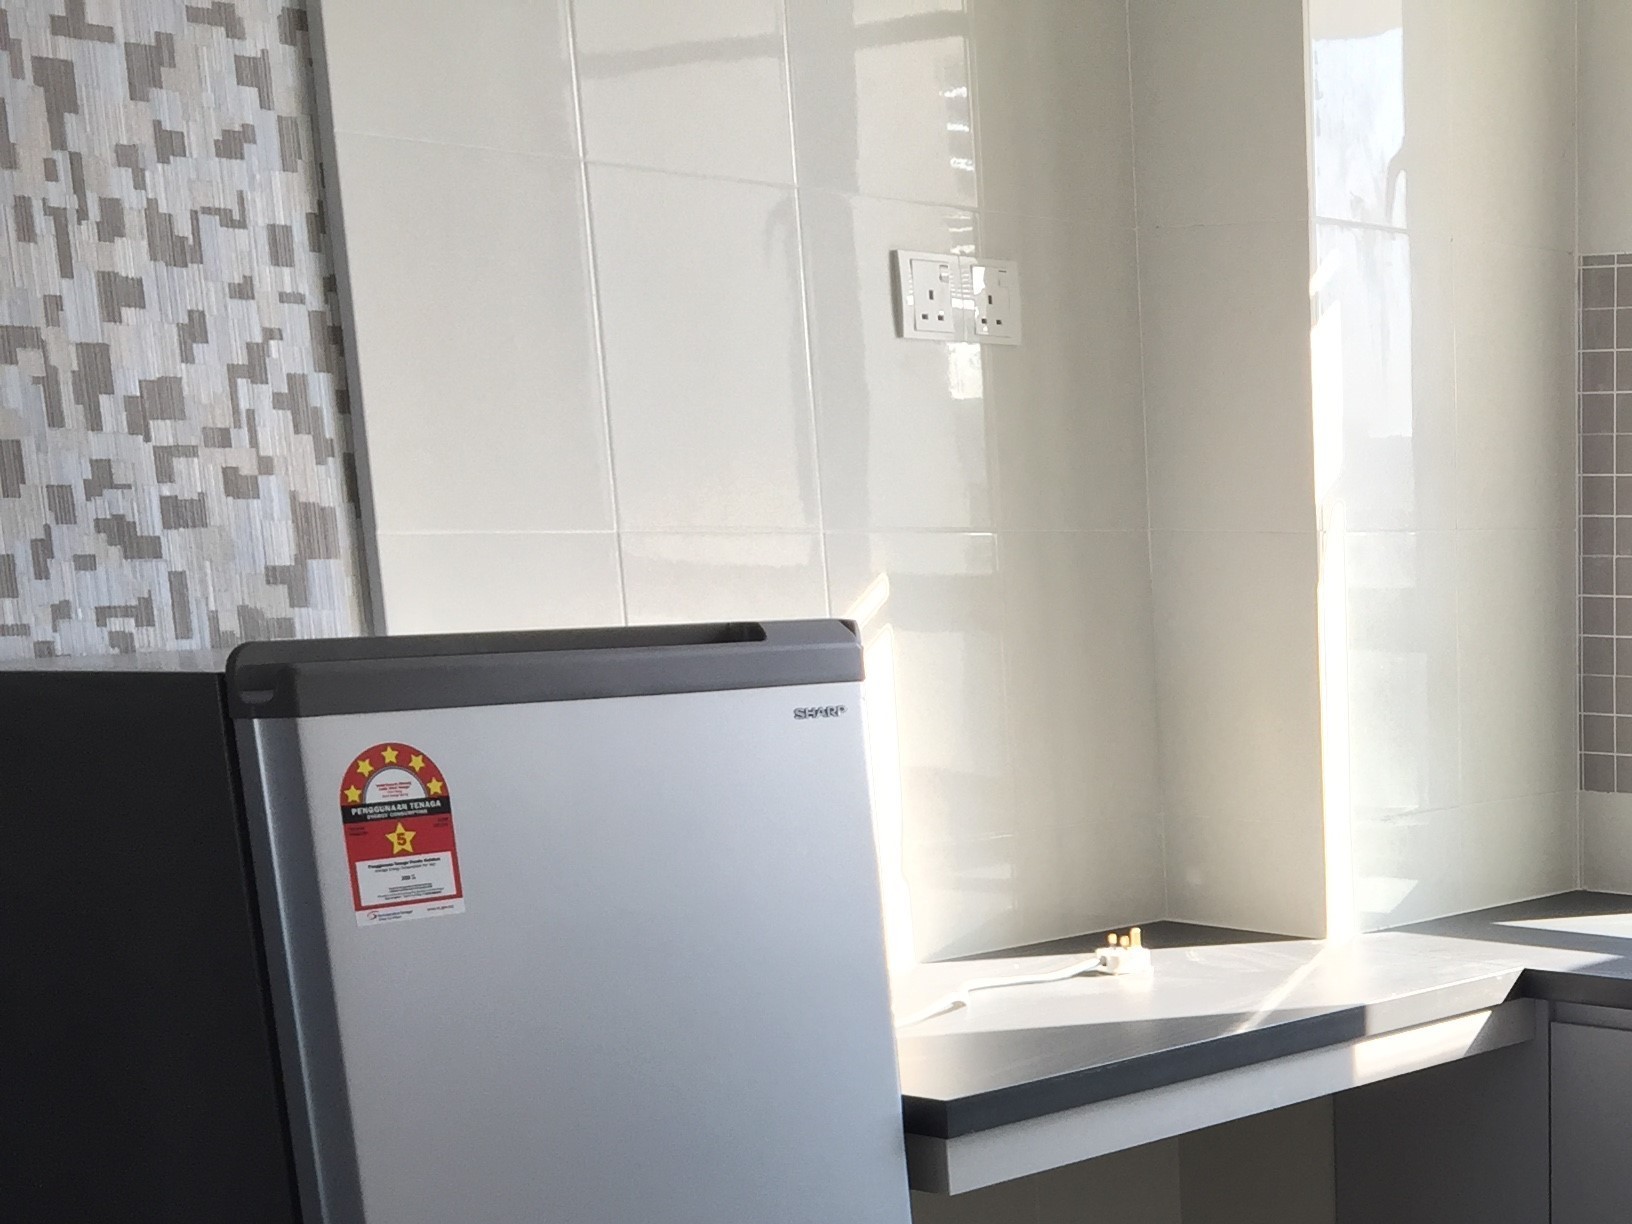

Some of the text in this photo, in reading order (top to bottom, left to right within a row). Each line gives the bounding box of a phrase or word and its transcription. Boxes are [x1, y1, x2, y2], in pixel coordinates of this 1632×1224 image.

[793, 705, 848, 719] SHARP
[351, 800, 442, 815] PENGGUNAAN TENAGA
[396, 833, 407, 846] 5
